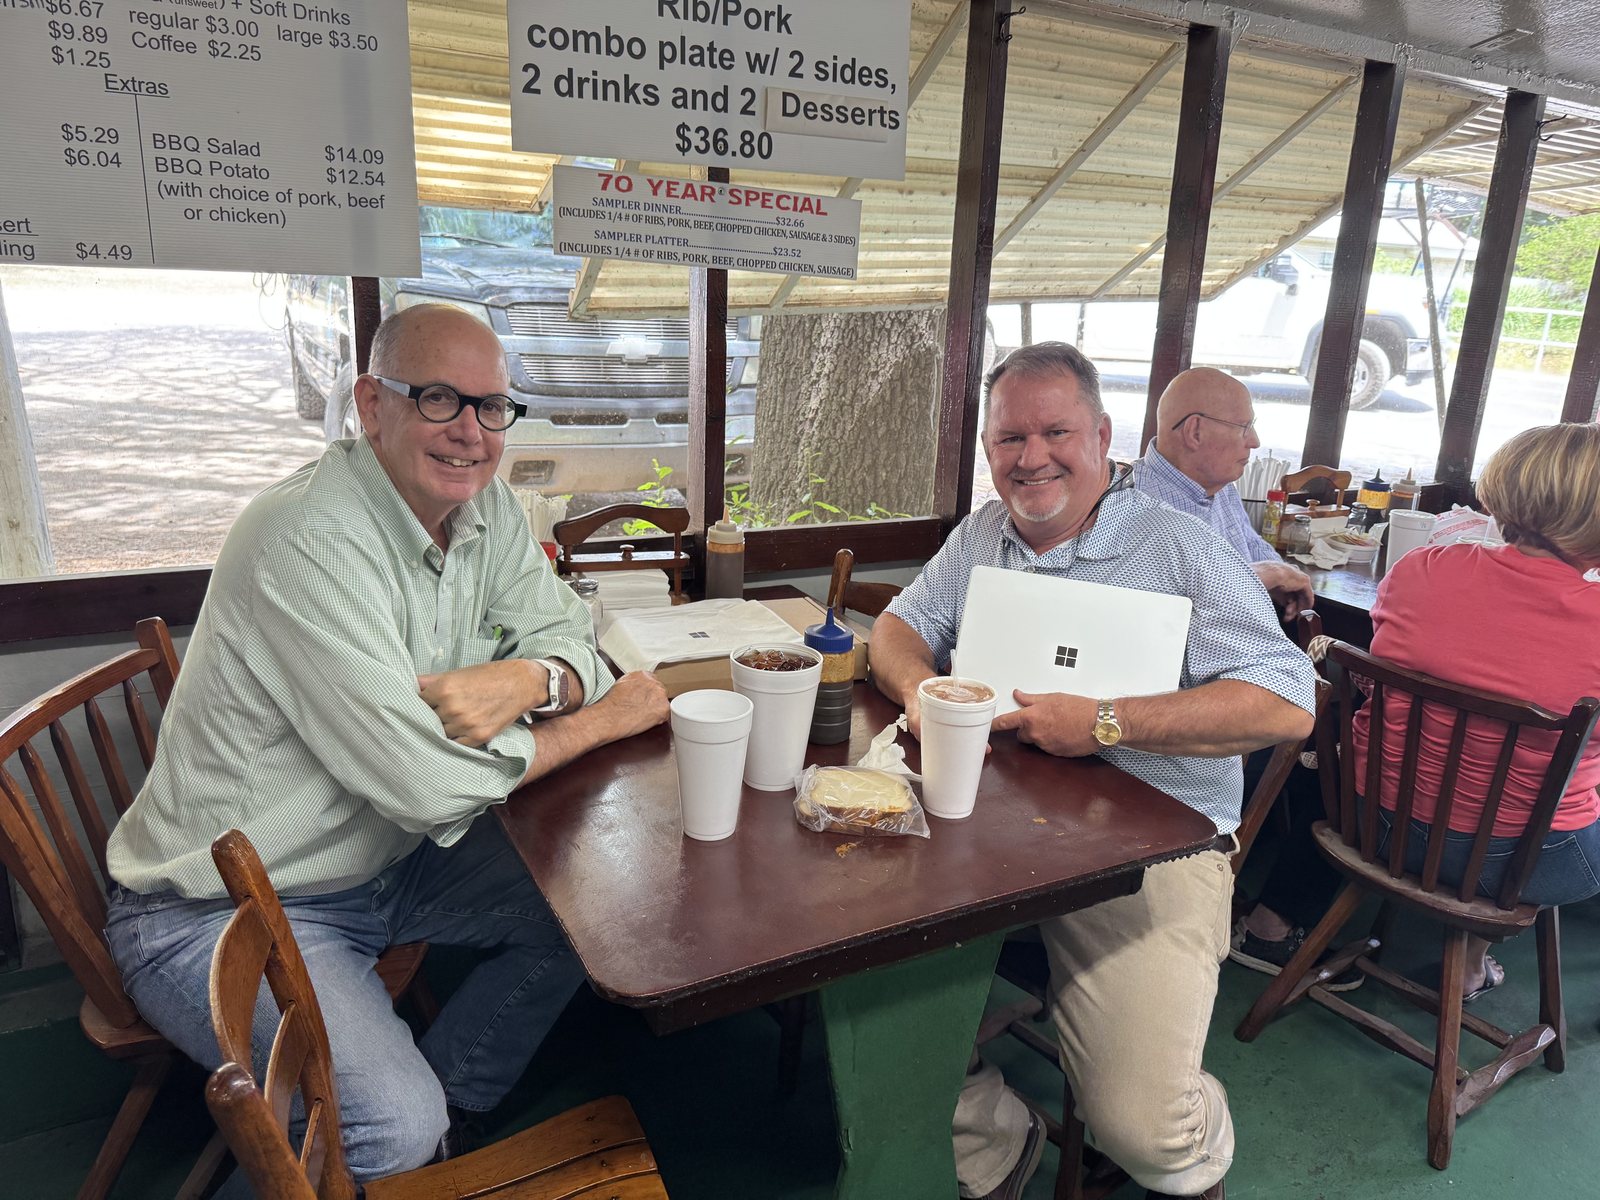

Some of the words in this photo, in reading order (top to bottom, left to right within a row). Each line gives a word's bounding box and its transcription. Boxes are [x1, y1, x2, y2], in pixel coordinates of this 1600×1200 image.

[46, 0, 103, 20] $6.67
[129, 8, 200, 35] regular
[206, 14, 259, 38] $3.00
[250, 0, 288, 18] Soft
[293, 3, 351, 26] Drinks
[48, 20, 108, 44] $9.89
[131, 31, 197, 54] Coffee
[208, 39, 262, 62] $2.25
[277, 25, 323, 48] large
[328, 29, 378, 52] $3.50
[51, 45, 111, 69] $1.25
[527, 24, 646, 60] combo
[658, 35, 735, 71] plate
[745, 47, 780, 76] w/
[788, 50, 804, 79] 2
[814, 56, 897, 94] sides,
[104, 73, 169, 95] Extras
[521, 62, 542, 95] 2
[553, 68, 660, 106] drinks
[671, 85, 729, 114] and
[739, 87, 756, 116] 2
[781, 91, 900, 130] Desserts
[61, 122, 120, 145] $5.29
[675, 122, 773, 160] $36.80
[64, 147, 122, 169] $6.04
[152, 133, 200, 154] BBQ
[206, 136, 261, 158] Salad
[324, 144, 384, 165] $14.09
[155, 157, 203, 177] BBQ
[209, 161, 270, 181] Potato
[326, 167, 385, 187] $12.54
[157, 179, 204, 200] (with
[209, 184, 269, 203] choice
[275, 189, 294, 204] of
[298, 191, 343, 209] pork,
[347, 193, 385, 208] beef
[598, 173, 633, 193] 70
[647, 178, 716, 203] YEAR
[728, 188, 828, 216] SPECIAL
[0, 218, 32, 233] ert
[183, 206, 204, 221] or
[209, 206, 286, 228] chicken)
[559, 206, 606, 220] (INCLUDES
[608, 212, 622, 222] 1/4
[632, 214, 643, 223] OF
[644, 215, 665, 227] RIBS,
[667, 218, 692, 229] PORK,
[694, 220, 714, 232] BEEF,
[716, 223, 752, 234] CHOPPED
[754, 226, 788, 240] CHICKEN,
[789, 230, 821, 242] SAUSAGE
[822, 234, 827, 242] &
[833, 235, 855, 247] SIDES)
[592, 197, 640, 210] SAMPLER
[776, 216, 804, 228] $32.66
[0, 240, 35, 261] ing
[76, 242, 132, 261] $4.49
[594, 230, 642, 243] SAMPLER
[773, 247, 802, 258] $23.52
[559, 242, 612, 255] (INCLUDES
[615, 247, 631, 258] 1/4
[642, 250, 654, 259] OF
[656, 251, 680, 262] RIBS,
[682, 253, 710, 265] PORK,
[712, 256, 735, 267] BEEF,
[737, 258, 776, 269] CHOPPED
[778, 262, 816, 274] CHICKEN,
[818, 265, 854, 278] SAUSAGE)
